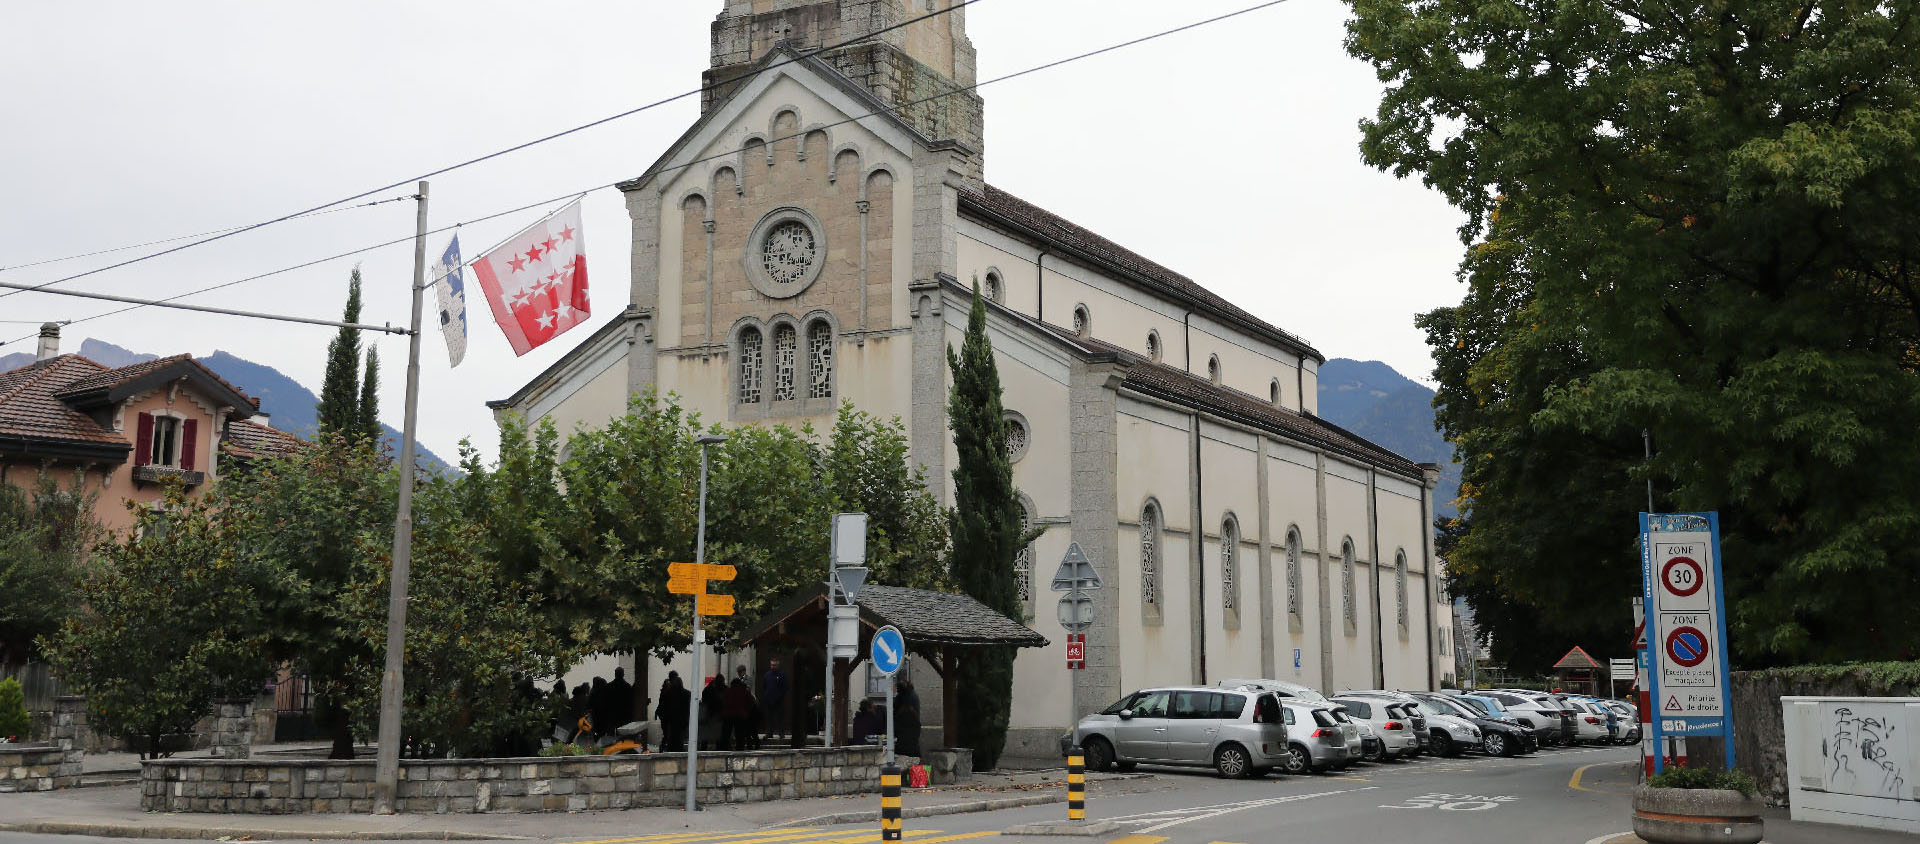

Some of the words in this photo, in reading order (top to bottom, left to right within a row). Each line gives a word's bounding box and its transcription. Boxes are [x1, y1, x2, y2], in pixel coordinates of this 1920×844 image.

[1668, 545, 1694, 555] ZONE
[1674, 569, 1692, 584] 30
[1672, 615, 1698, 624] ZONE
[1665, 668, 1690, 677] Excepté
[1692, 669, 1713, 677] places
[1688, 694, 1716, 702] Priorité
[1686, 703, 1695, 711] de
[1697, 703, 1719, 711] droite
[1414, 792, 1520, 801] ZONE
[1377, 799, 1499, 811] 30
